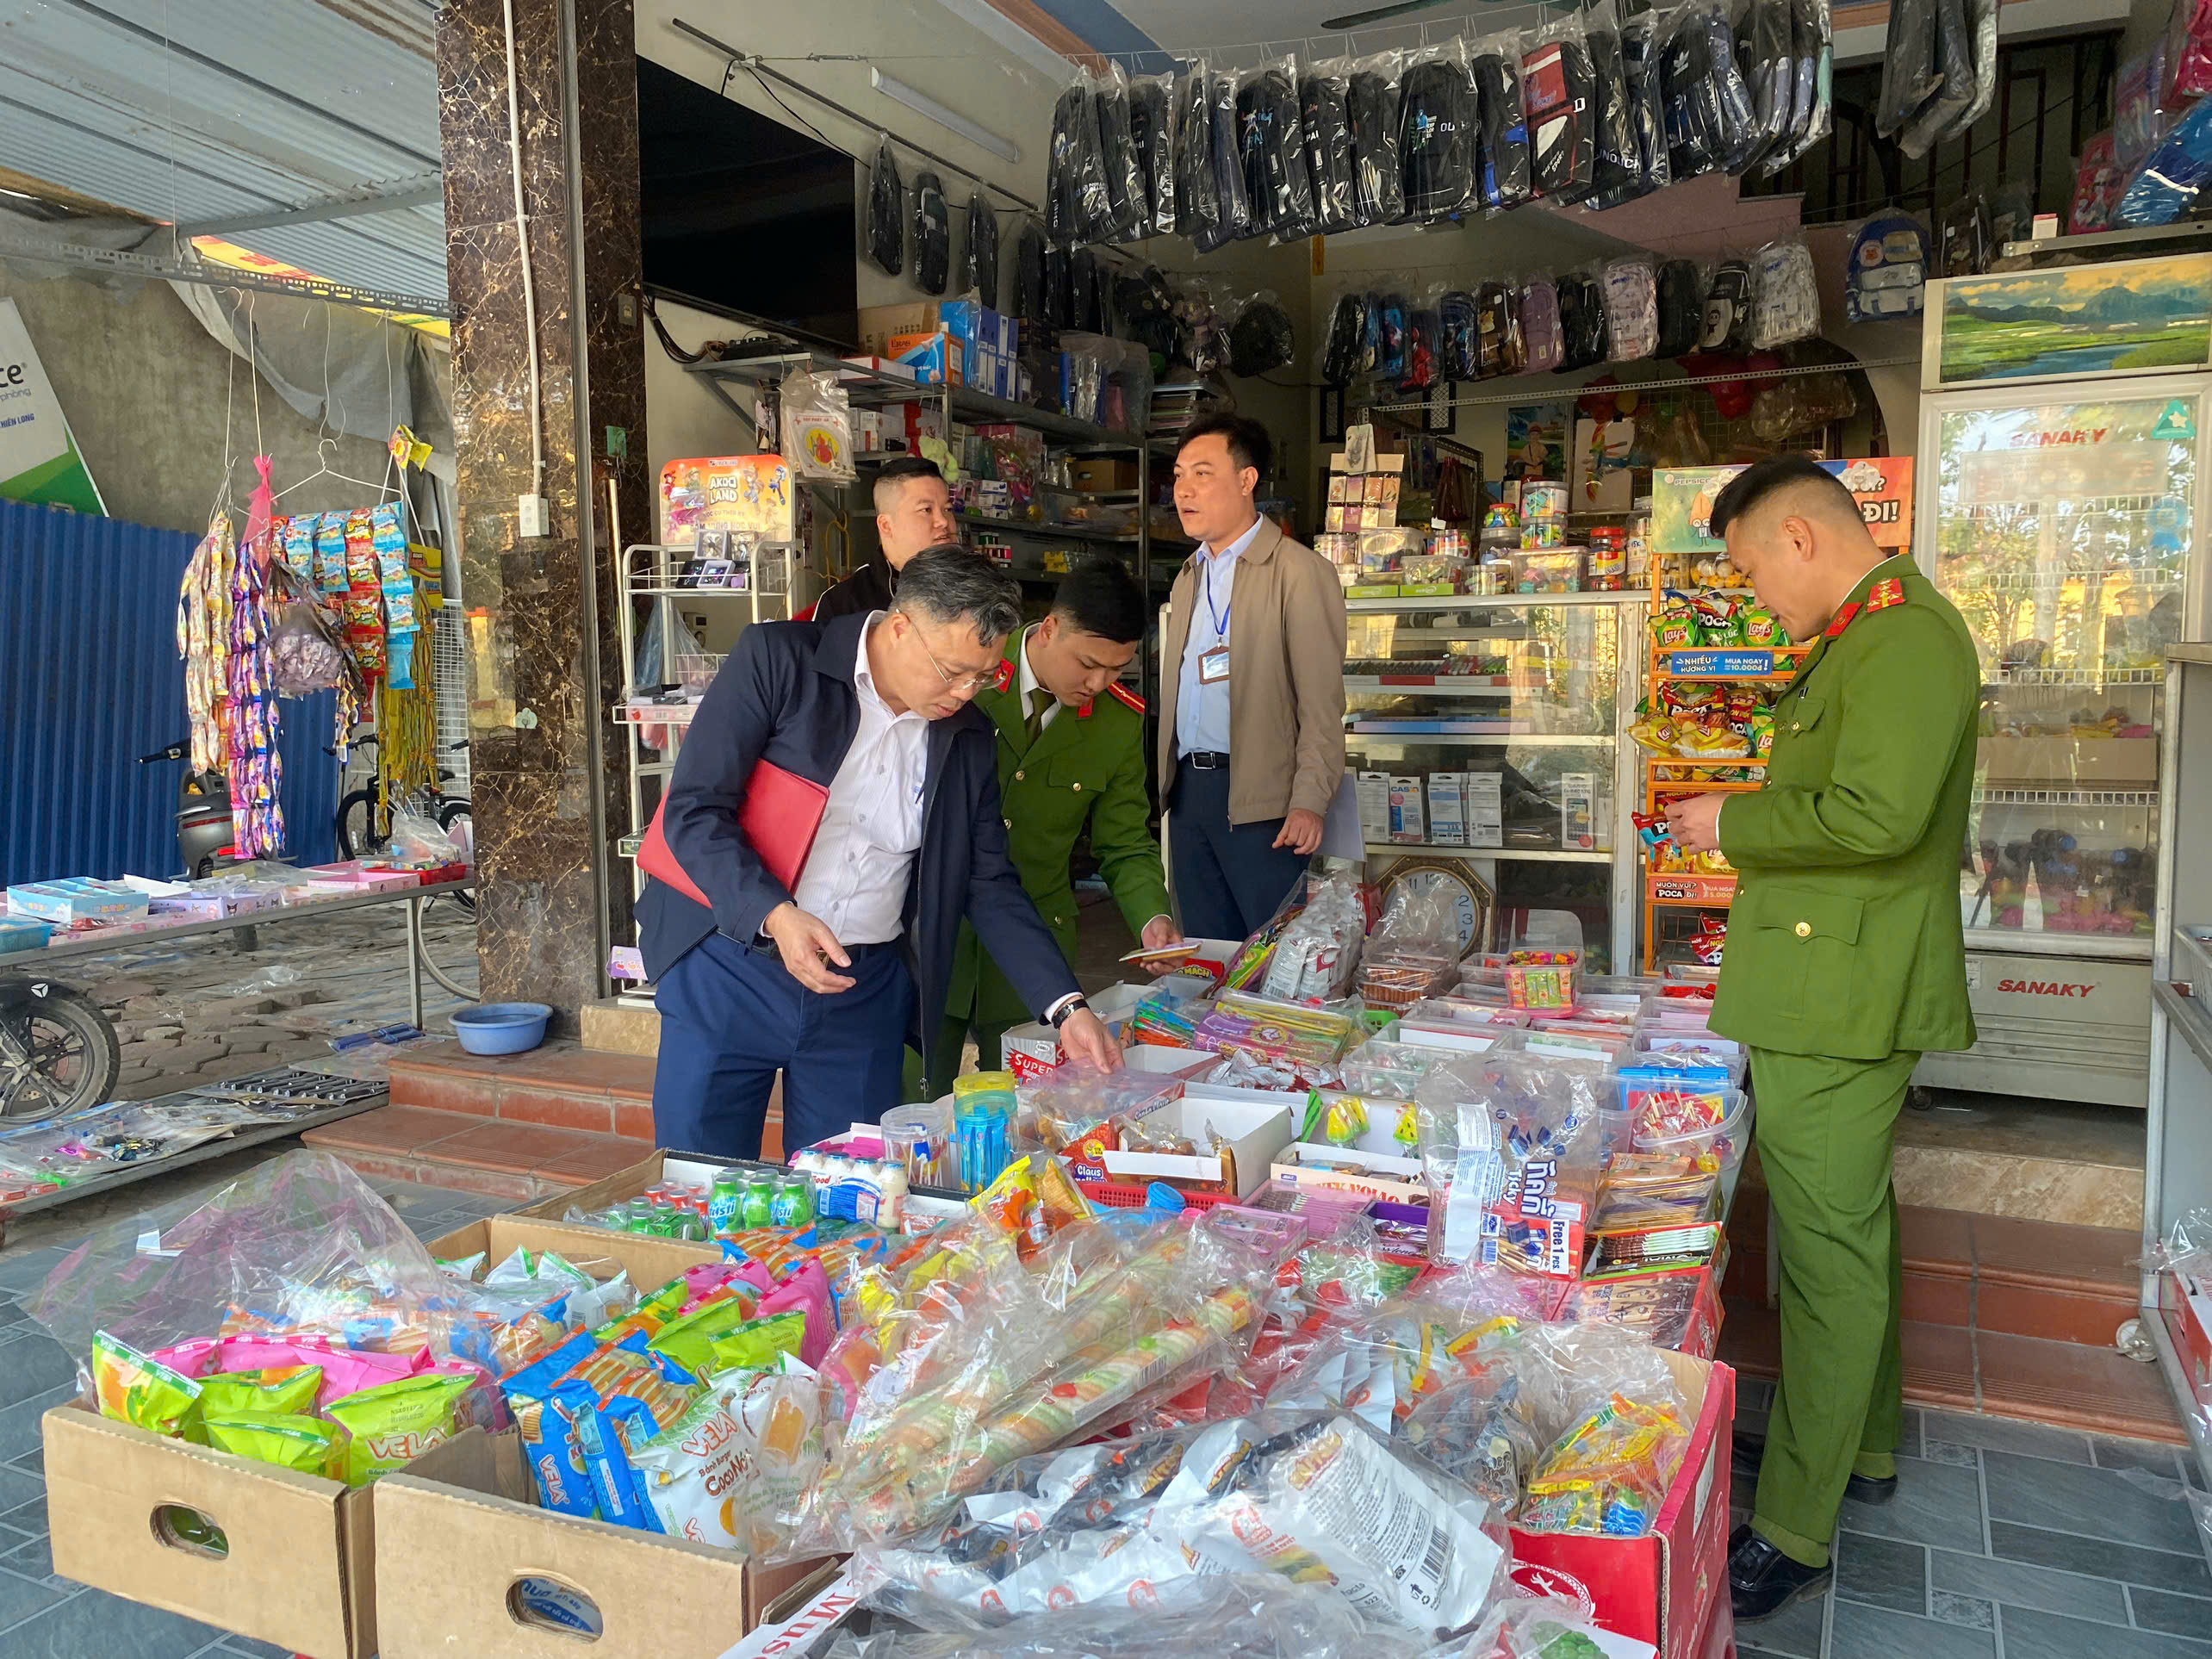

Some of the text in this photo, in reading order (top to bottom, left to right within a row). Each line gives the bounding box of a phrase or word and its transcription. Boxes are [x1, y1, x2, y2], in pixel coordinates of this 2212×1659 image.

[17, 413, 34, 424] LONG
[2009, 428, 2108, 448] SANAKY
[709, 488, 738, 505] LAND
[1863, 500, 1902, 523] ĐI!
[1408, 877, 1418, 889] 11
[1458, 895, 1469, 907] 2
[1658, 890, 1683, 898] POCA
[1462, 913, 1474, 925] 3
[1458, 930, 1469, 941] 4
[1998, 979, 2096, 998] SANAKY
[1077, 1165, 1103, 1177] Claus
[1501, 1169, 1523, 1206] Ticky
[1552, 1221, 1565, 1246] Free
[367, 1426, 449, 1460] VELA
[681, 1411, 739, 1457] VELA
[538, 1454, 569, 1505] VELA
[751, 1592, 855, 1659] Mus
